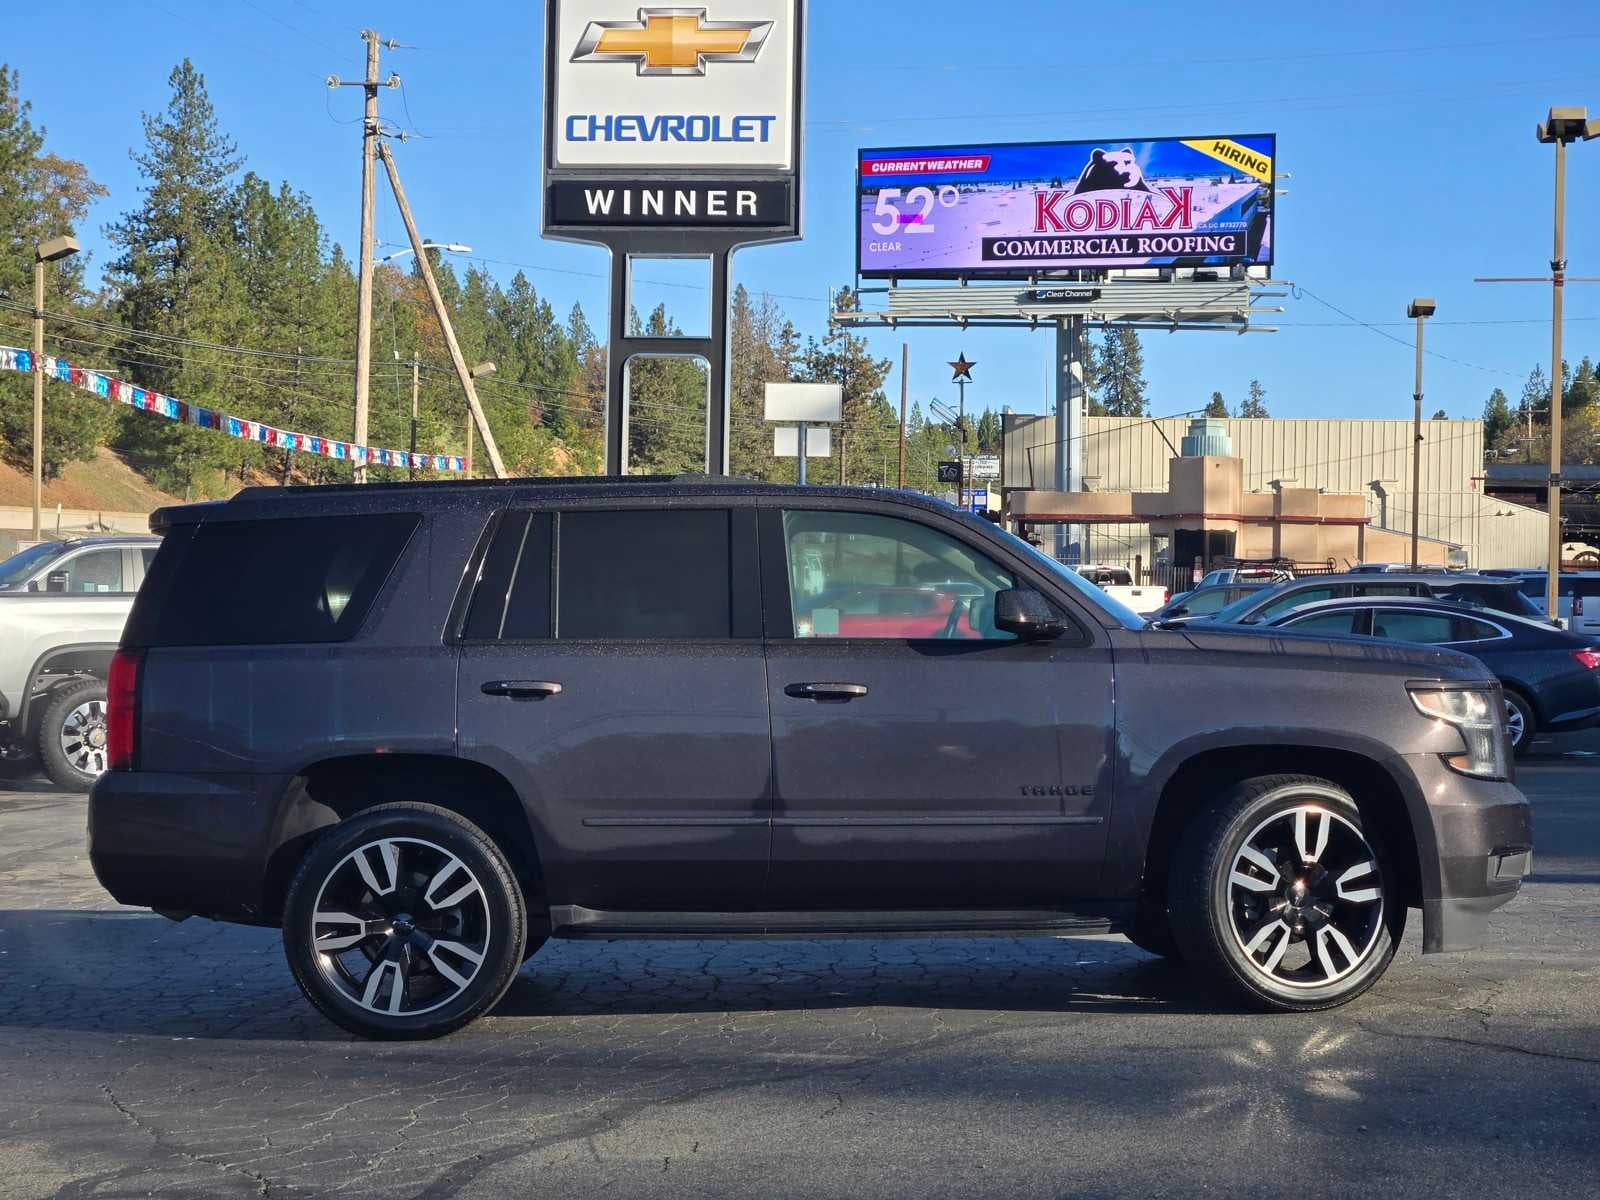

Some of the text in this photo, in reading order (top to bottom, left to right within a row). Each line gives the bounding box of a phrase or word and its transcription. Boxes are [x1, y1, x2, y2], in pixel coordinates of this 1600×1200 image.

[565, 115, 777, 142] CHEVROLET
[871, 159, 983, 172] CURRENT WEATHER
[1213, 141, 1269, 174] HIRING
[584, 189, 758, 216] WINNER
[1034, 186, 1194, 232] KODIAK
[868, 241, 902, 253] CLEAR
[992, 235, 1236, 257] COMMERCIAL ROOFING
[1046, 290, 1093, 298] Clear Channel
[1018, 785, 1096, 796] TAHOE
